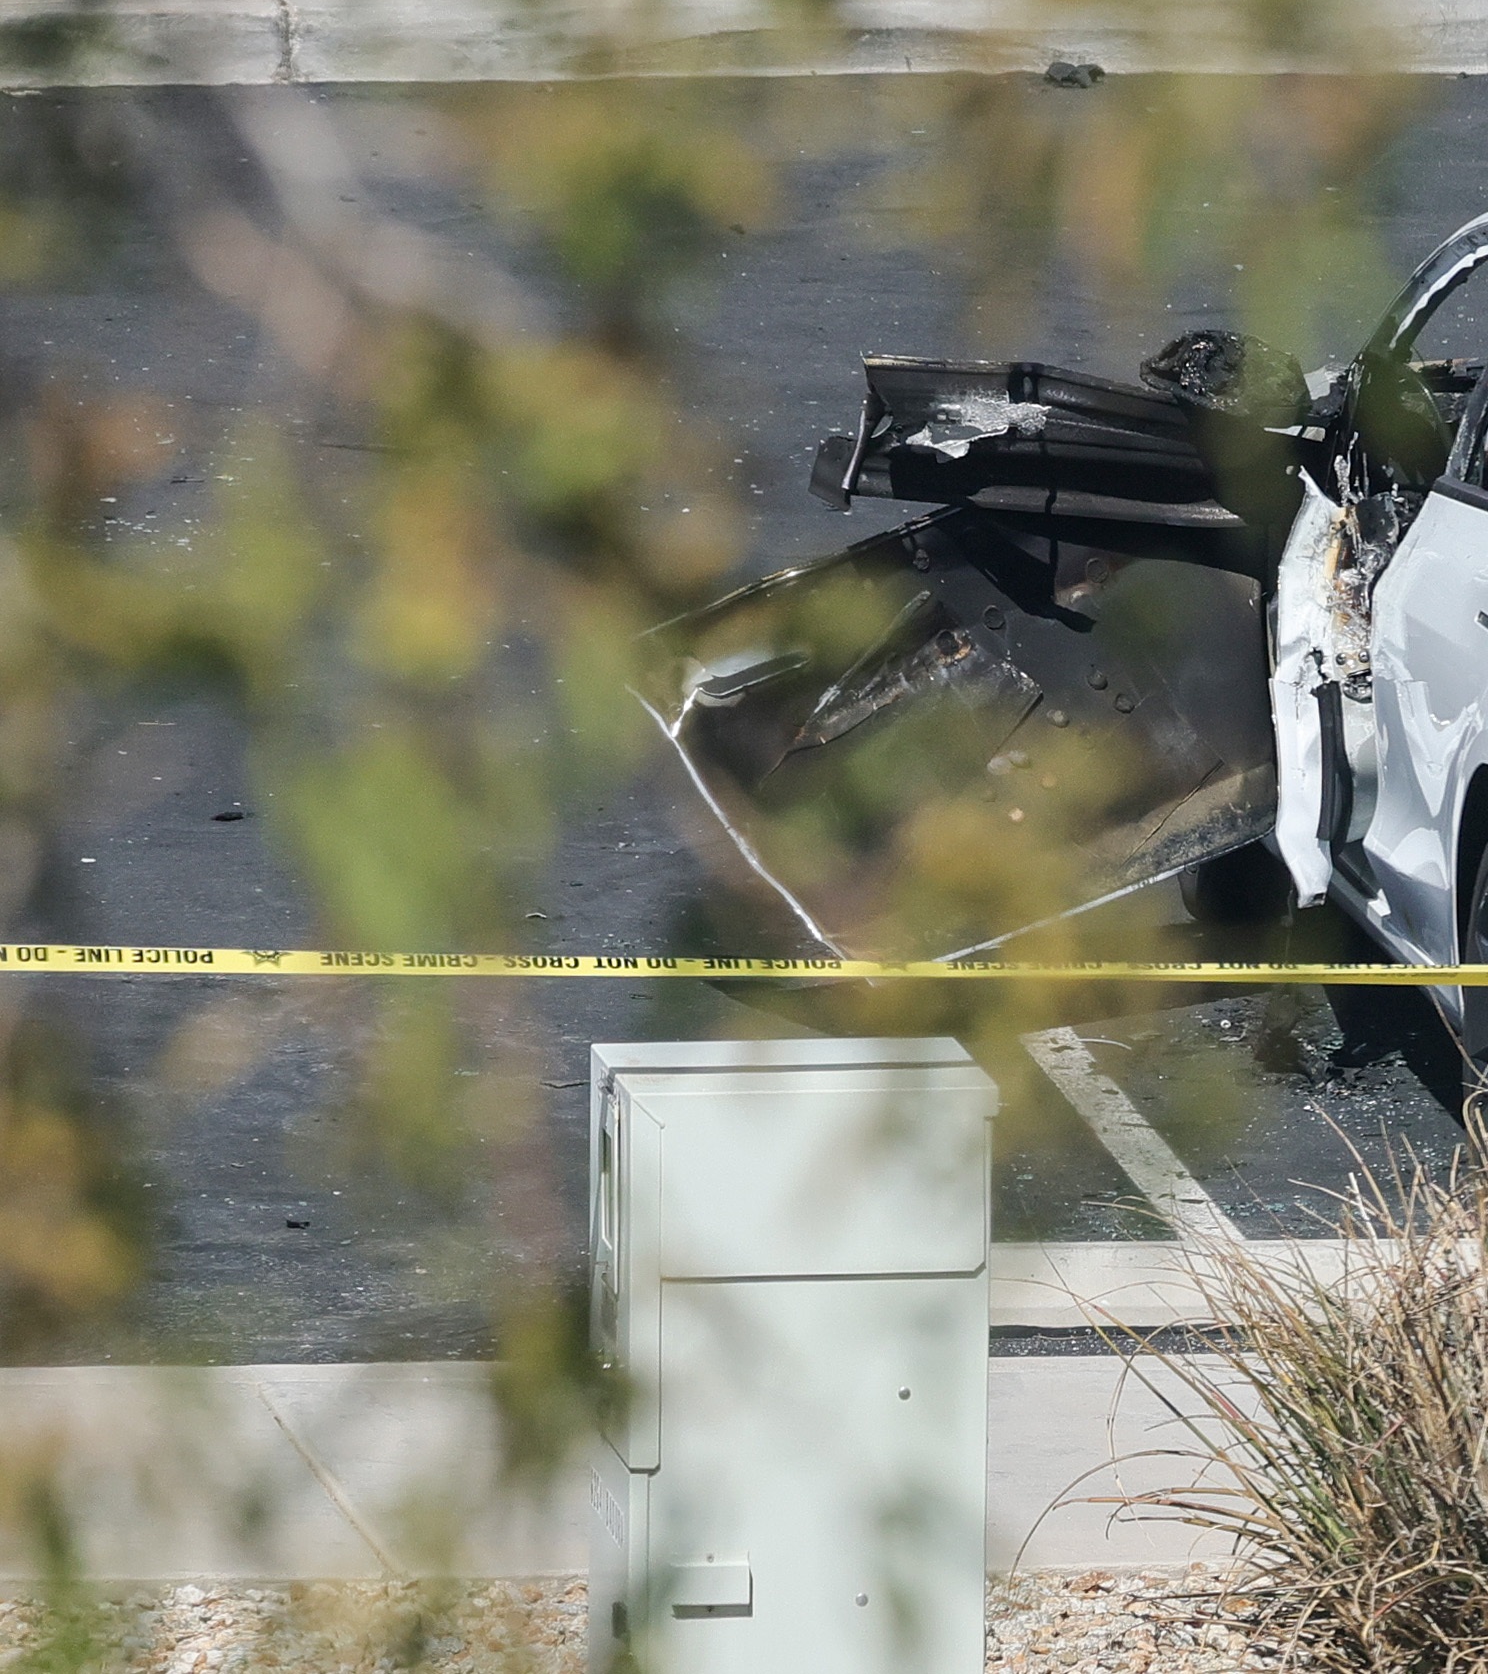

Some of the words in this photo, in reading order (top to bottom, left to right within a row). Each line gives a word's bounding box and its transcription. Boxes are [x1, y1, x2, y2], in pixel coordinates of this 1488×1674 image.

[16, 946, 49, 963] DO
[74, 947, 124, 964] LINE
[132, 948, 214, 965] POLICE
